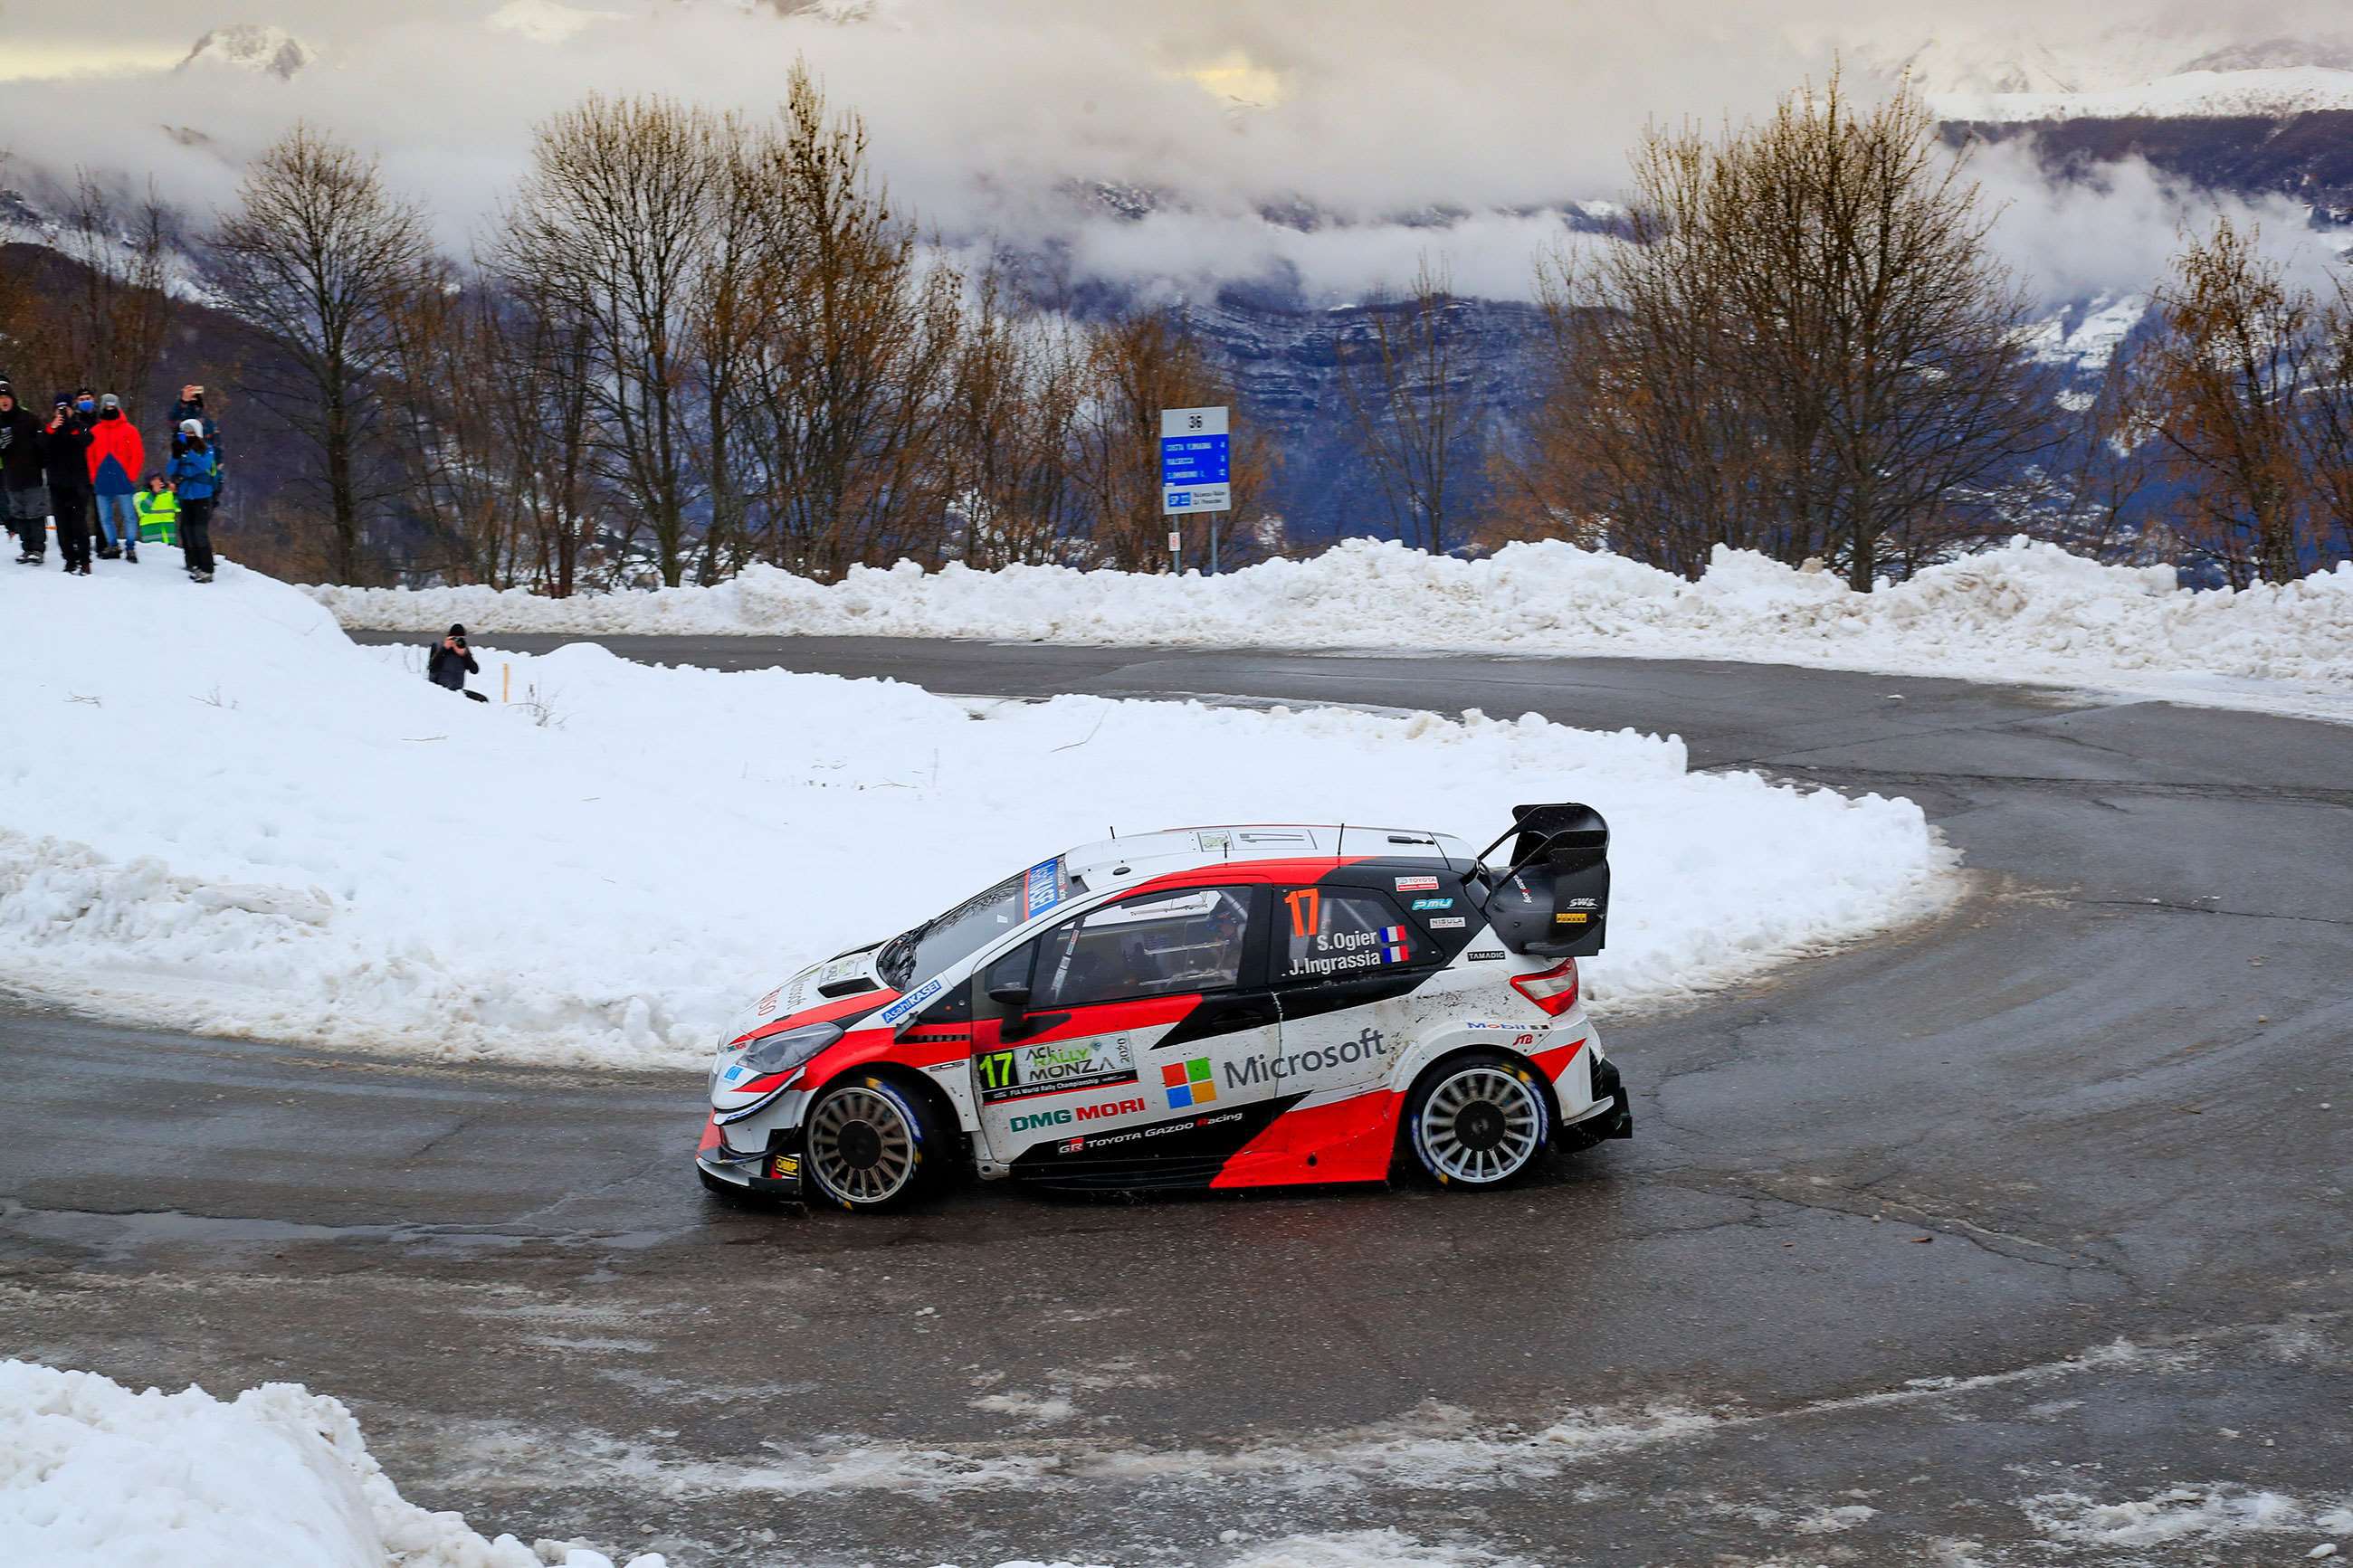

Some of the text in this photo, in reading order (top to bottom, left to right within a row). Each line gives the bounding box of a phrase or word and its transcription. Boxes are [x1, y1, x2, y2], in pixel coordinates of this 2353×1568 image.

[1188, 415, 1203, 429] 36
[1283, 888, 1319, 937] 17
[1316, 931, 1377, 951] S.Ogier
[1289, 950, 1381, 975] J.Ingrassia
[1468, 952, 1505, 960] TAMADIC
[884, 981, 940, 1022] AsahiKASEI
[1118, 1038, 1130, 1063] 2020
[1512, 1034, 1533, 1046] JTB
[978, 1052, 1014, 1088] 17
[1029, 1057, 1116, 1082] MONZA
[1034, 1048, 1089, 1067] RALLY
[1224, 1027, 1386, 1088] Microsoft
[1041, 1083, 1056, 1092] Rally
[1057, 1077, 1100, 1089] Championship
[1009, 1098, 1146, 1133] DMG MORI
[1058, 1112, 1243, 1154] GR TOYOTA GAZOO Racing
[776, 1158, 798, 1172] OMP
